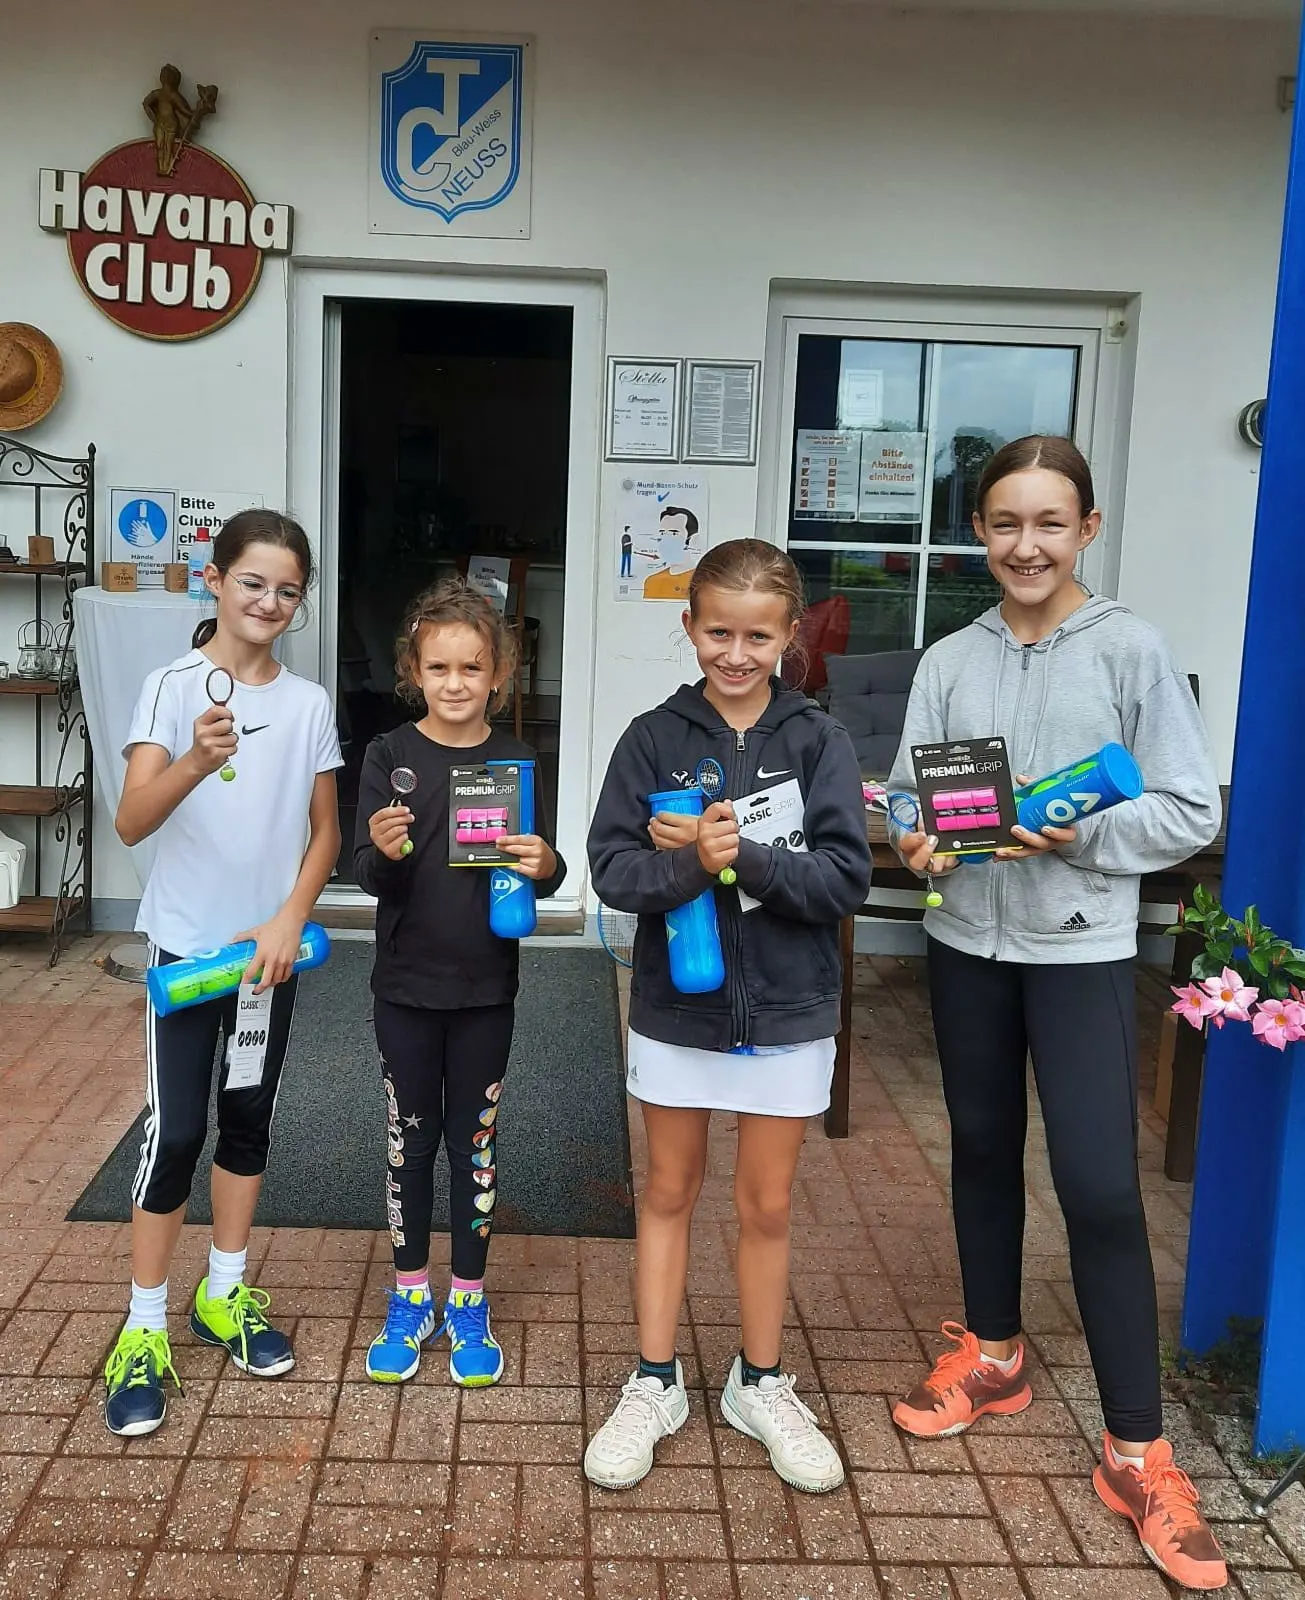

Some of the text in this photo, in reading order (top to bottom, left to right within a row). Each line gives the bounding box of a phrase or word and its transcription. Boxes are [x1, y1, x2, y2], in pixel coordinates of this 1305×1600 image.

[451, 108, 502, 158] Blau-Weiss
[441, 137, 508, 204] NEUSS
[39, 169, 288, 250] Havana
[85, 242, 231, 311] Club
[882, 448, 904, 458] Bitte
[871, 459, 914, 471] Abstände
[869, 471, 915, 482] einhalten!
[637, 489, 656, 497] tragen
[181, 497, 215, 509] Bitte
[178, 514, 224, 527] Clubh
[921, 760, 1003, 778] PREMIUM GRIP
[455, 784, 516, 796] PREMIUM GRIP
[740, 807, 773, 828] ASSIC
[1060, 922, 1091, 931] adidas
[240, 1000, 259, 1010] CLASSIC
